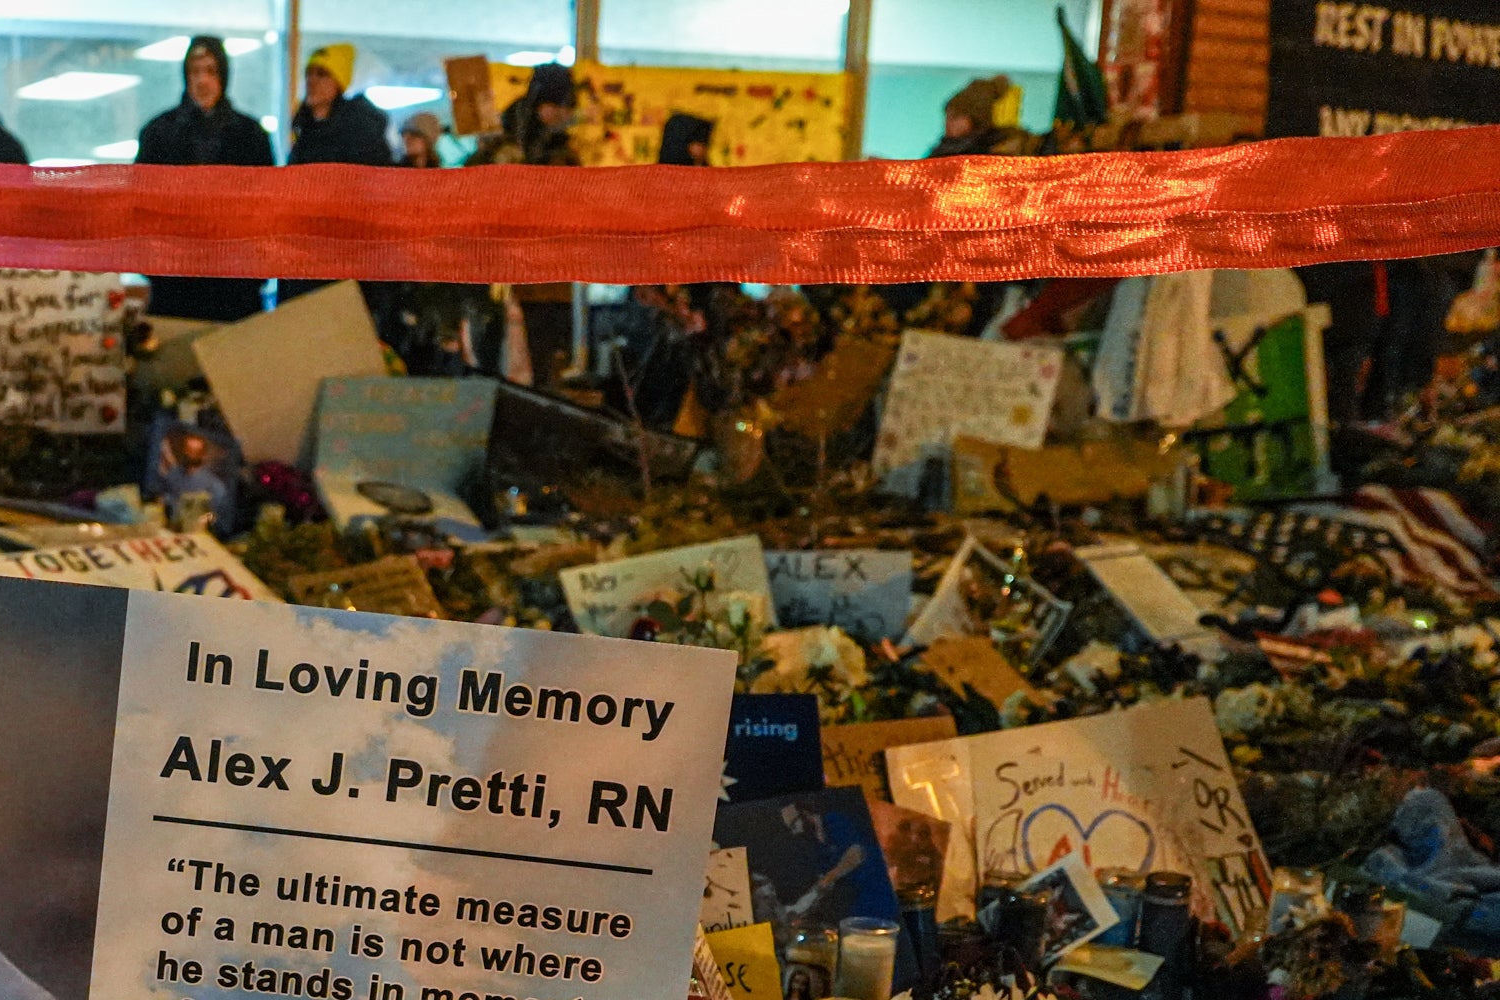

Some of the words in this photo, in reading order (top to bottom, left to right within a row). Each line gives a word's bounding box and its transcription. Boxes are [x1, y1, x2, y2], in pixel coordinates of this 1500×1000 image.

[1429, 16, 1500, 69] POWE
[8, 535, 204, 580] TOGETHER
[771, 554, 867, 582] ALEX
[186, 641, 233, 686] In
[255, 649, 438, 717] Loving
[458, 669, 675, 741] Memory
[735, 716, 798, 741] rising
[159, 736, 292, 791] Alex
[311, 752, 359, 798] J.
[386, 758, 561, 829] Pretti,
[587, 780, 673, 832] RN
[167, 858, 261, 897] “The
[276, 872, 440, 917] ultimate
[456, 896, 632, 938] measure
[161, 907, 203, 937] of
[214, 917, 235, 941] a
[251, 920, 335, 952] man
[350, 925, 385, 958] is
[400, 937, 467, 967] not
[480, 943, 602, 982] where
[156, 950, 203, 984] he
[217, 961, 353, 1000] stands
